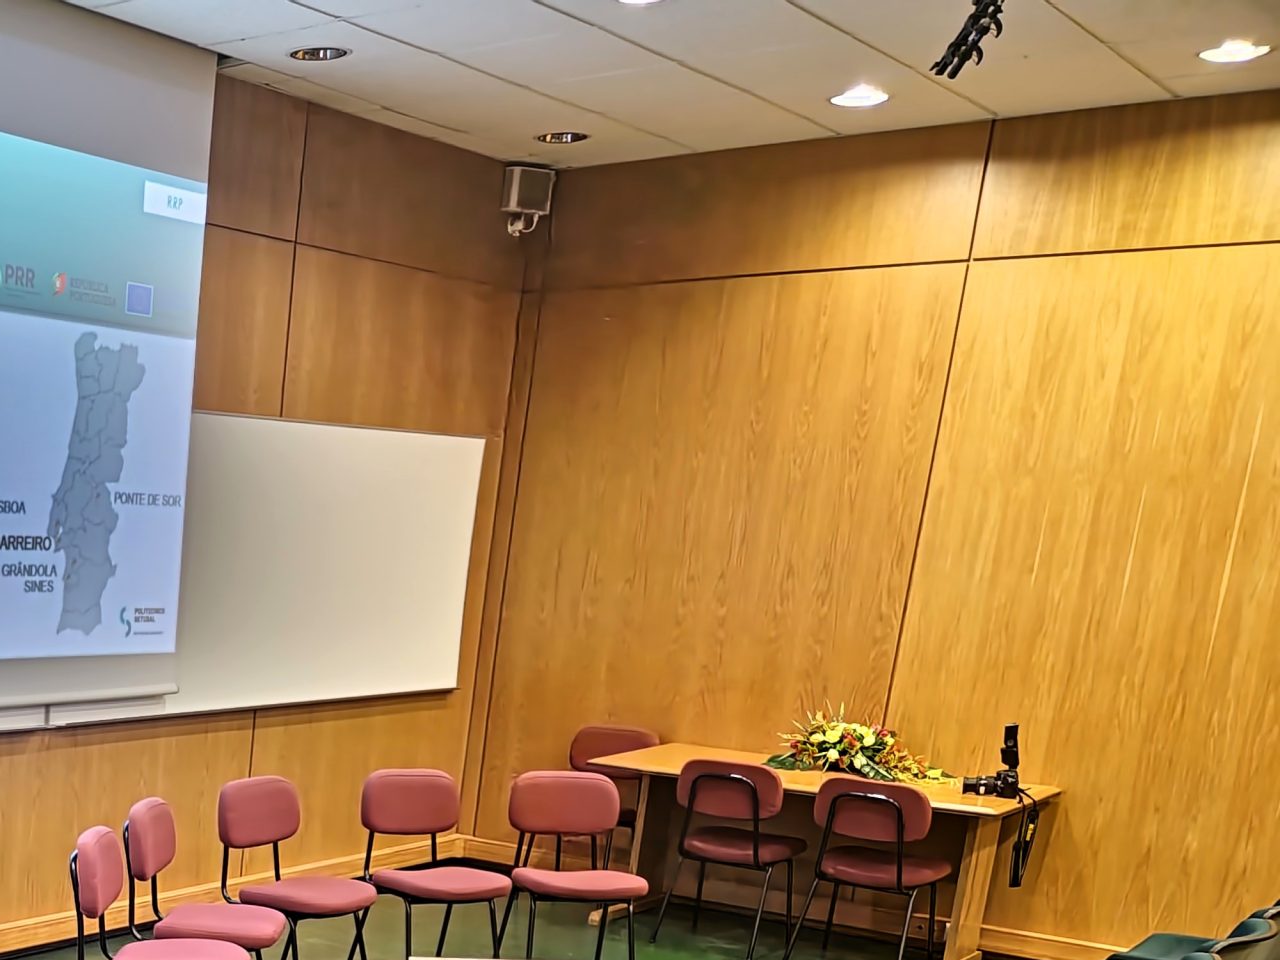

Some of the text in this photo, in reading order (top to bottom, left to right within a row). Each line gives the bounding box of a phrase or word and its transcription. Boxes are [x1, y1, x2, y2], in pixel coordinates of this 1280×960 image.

[167, 195, 183, 210] RRP
[5, 263, 36, 289] PRR
[114, 491, 182, 508] PONTE DE SOR
[1, 561, 58, 577] GRÂNDOLA
[24, 580, 54, 593] SINES
